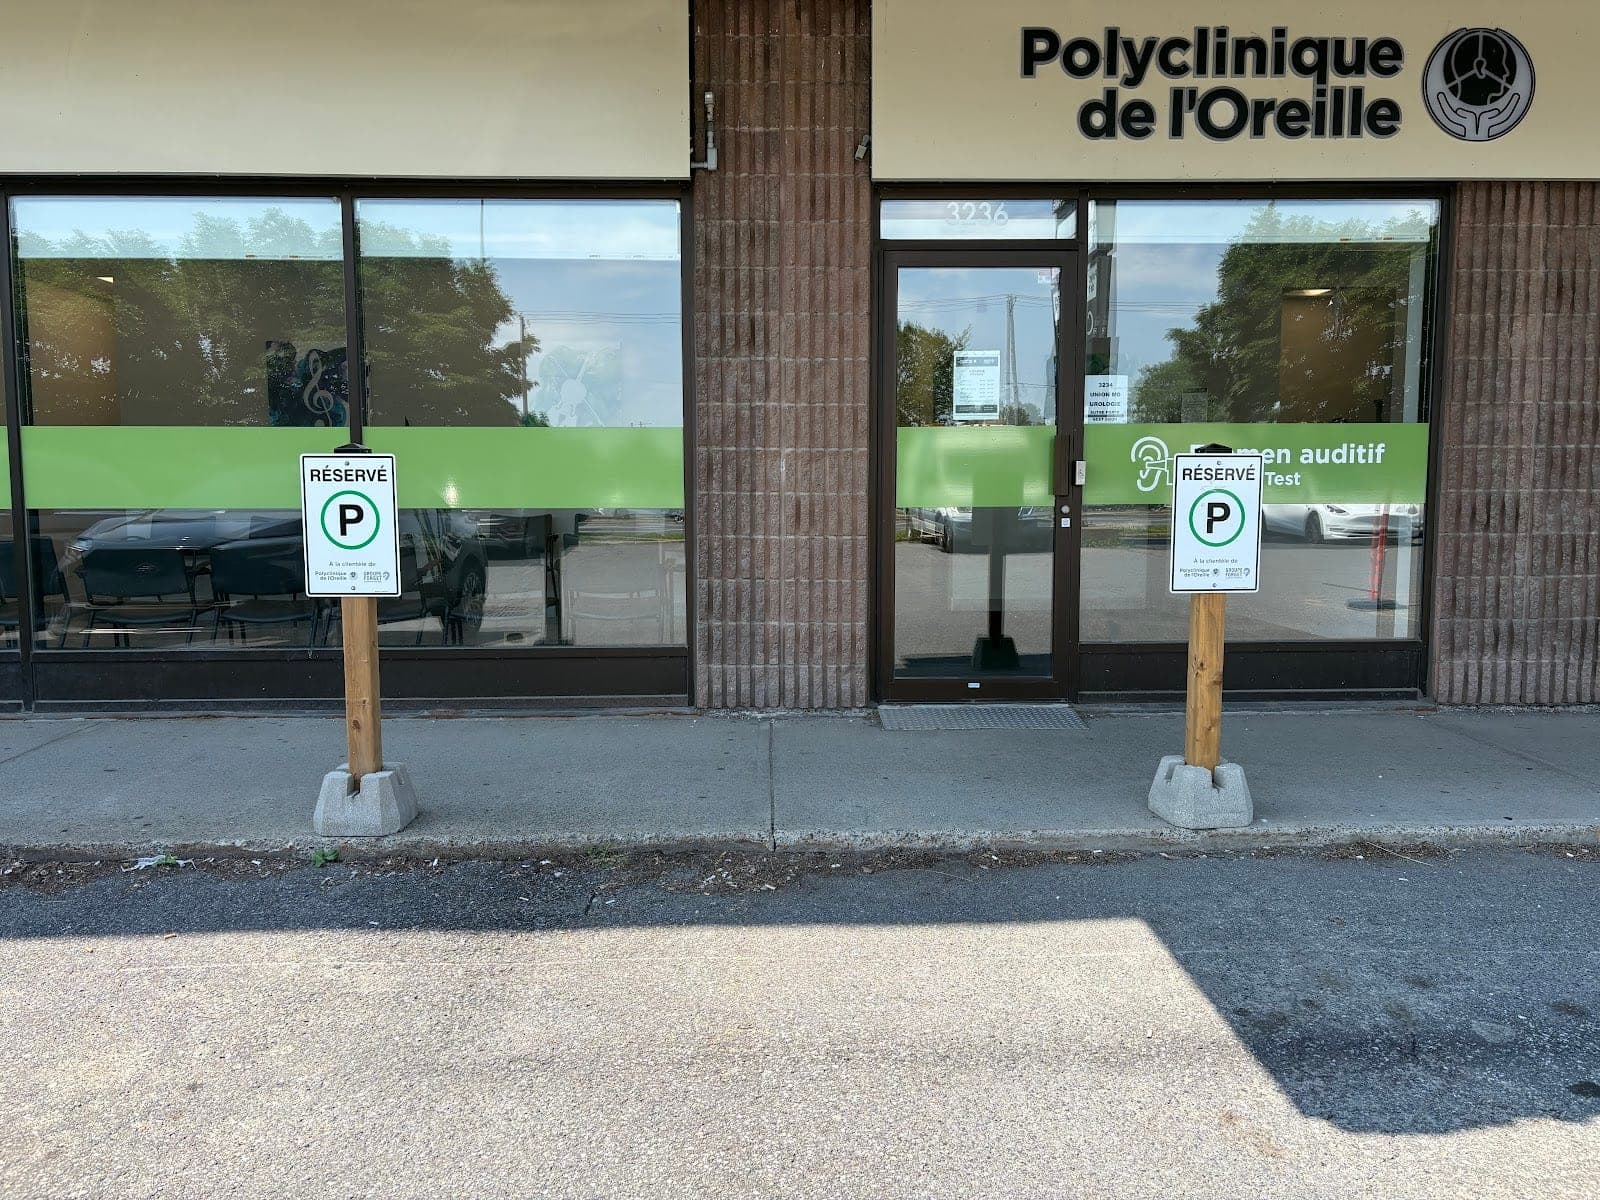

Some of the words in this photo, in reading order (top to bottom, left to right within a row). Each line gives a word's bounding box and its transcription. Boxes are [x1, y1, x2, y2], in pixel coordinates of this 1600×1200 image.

[1020, 26, 1405, 89] Polyclinique
[1077, 87, 1155, 139] de
[1168, 85, 1403, 141] l'Oreille
[945, 202, 1009, 226] 3236
[1300, 443, 1386, 464] auditif
[310, 465, 388, 482] RÉSERVÉ
[1182, 464, 1256, 481] RÉSERVÉ
[1264, 471, 1301, 486] Test
[339, 504, 364, 536] P
[1206, 502, 1231, 534] P
